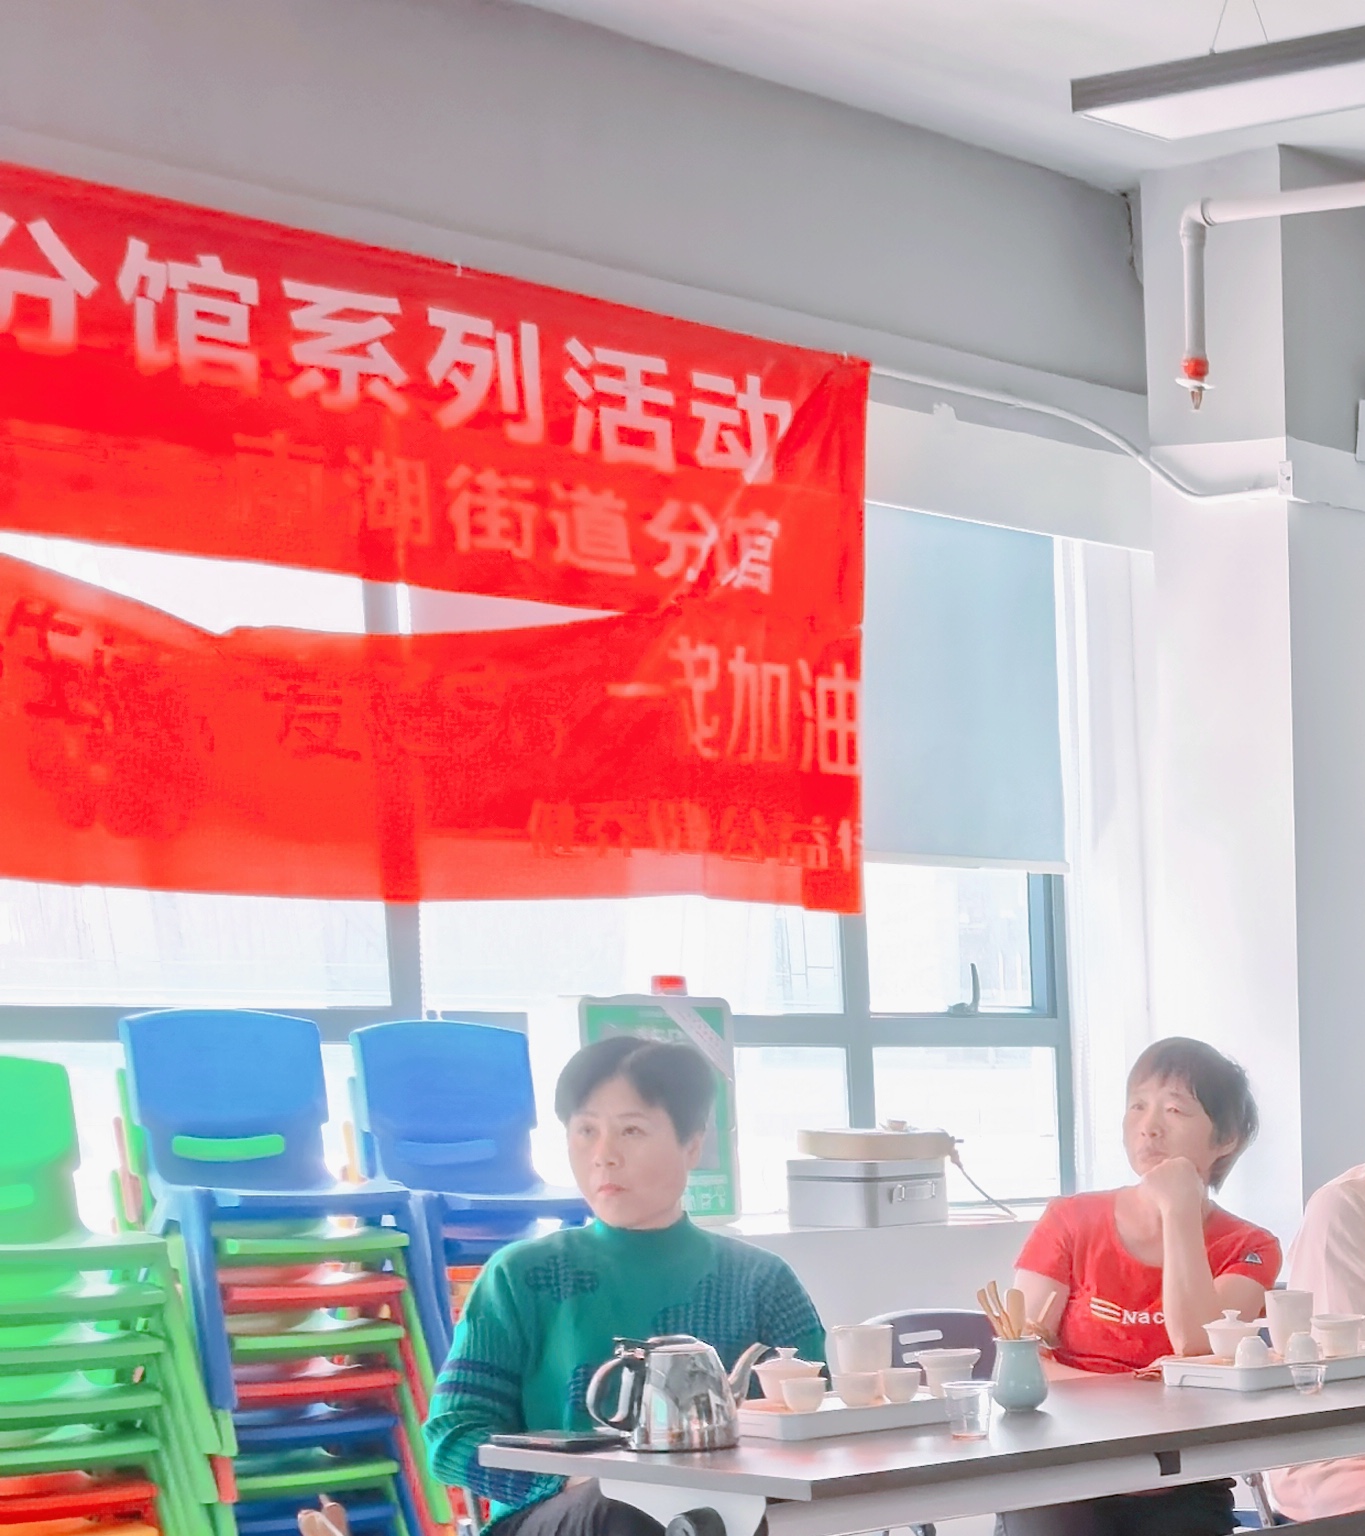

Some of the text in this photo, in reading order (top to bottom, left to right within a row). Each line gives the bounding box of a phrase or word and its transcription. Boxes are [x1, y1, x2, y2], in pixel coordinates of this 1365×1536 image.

[0, 211, 793, 484] 分馆系列活动
